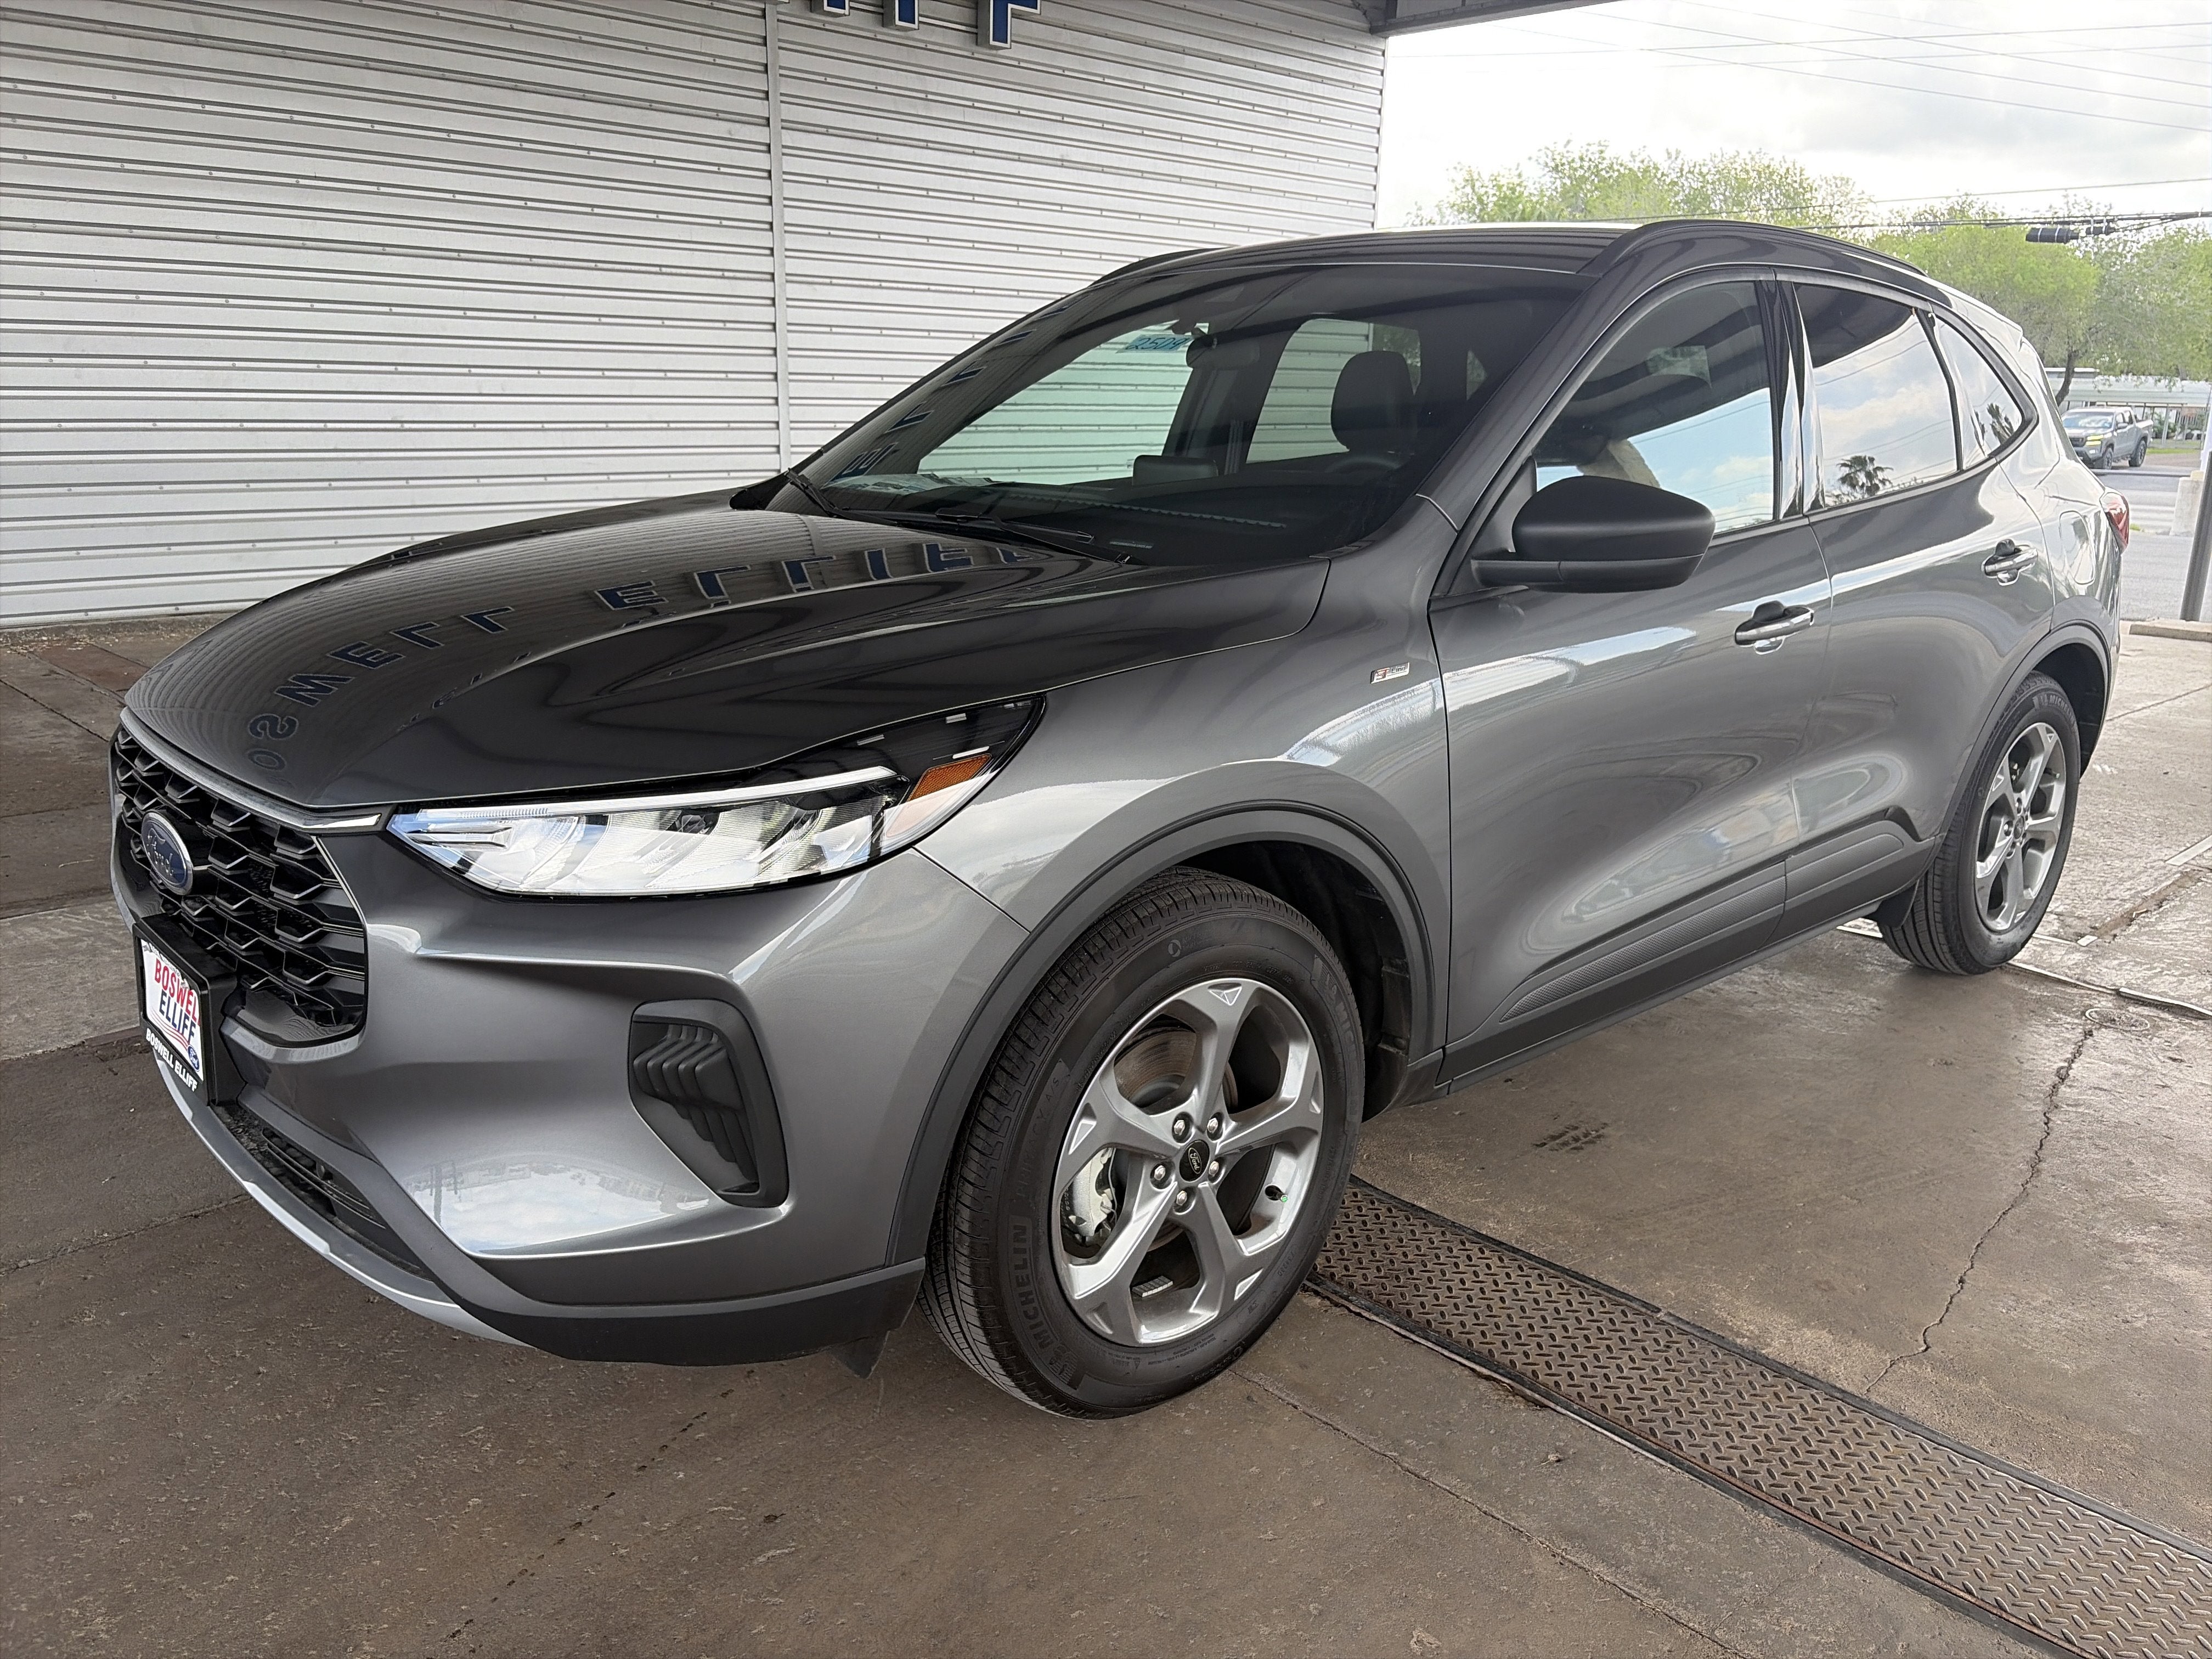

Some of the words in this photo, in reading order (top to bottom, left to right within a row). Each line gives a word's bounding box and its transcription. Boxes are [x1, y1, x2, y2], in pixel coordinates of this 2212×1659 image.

[1376, 668, 1390, 680] ST
[1391, 665, 1406, 674] Line
[154, 958, 201, 1026] BOSWEL
[159, 989, 196, 1045] ELLIFF
[146, 1028, 174, 1069] BOSWELL
[174, 1058, 198, 1092] ELLIFF
[1189, 1152, 1200, 1170] Ford
[1013, 1224, 1054, 1350] MICHELIN
